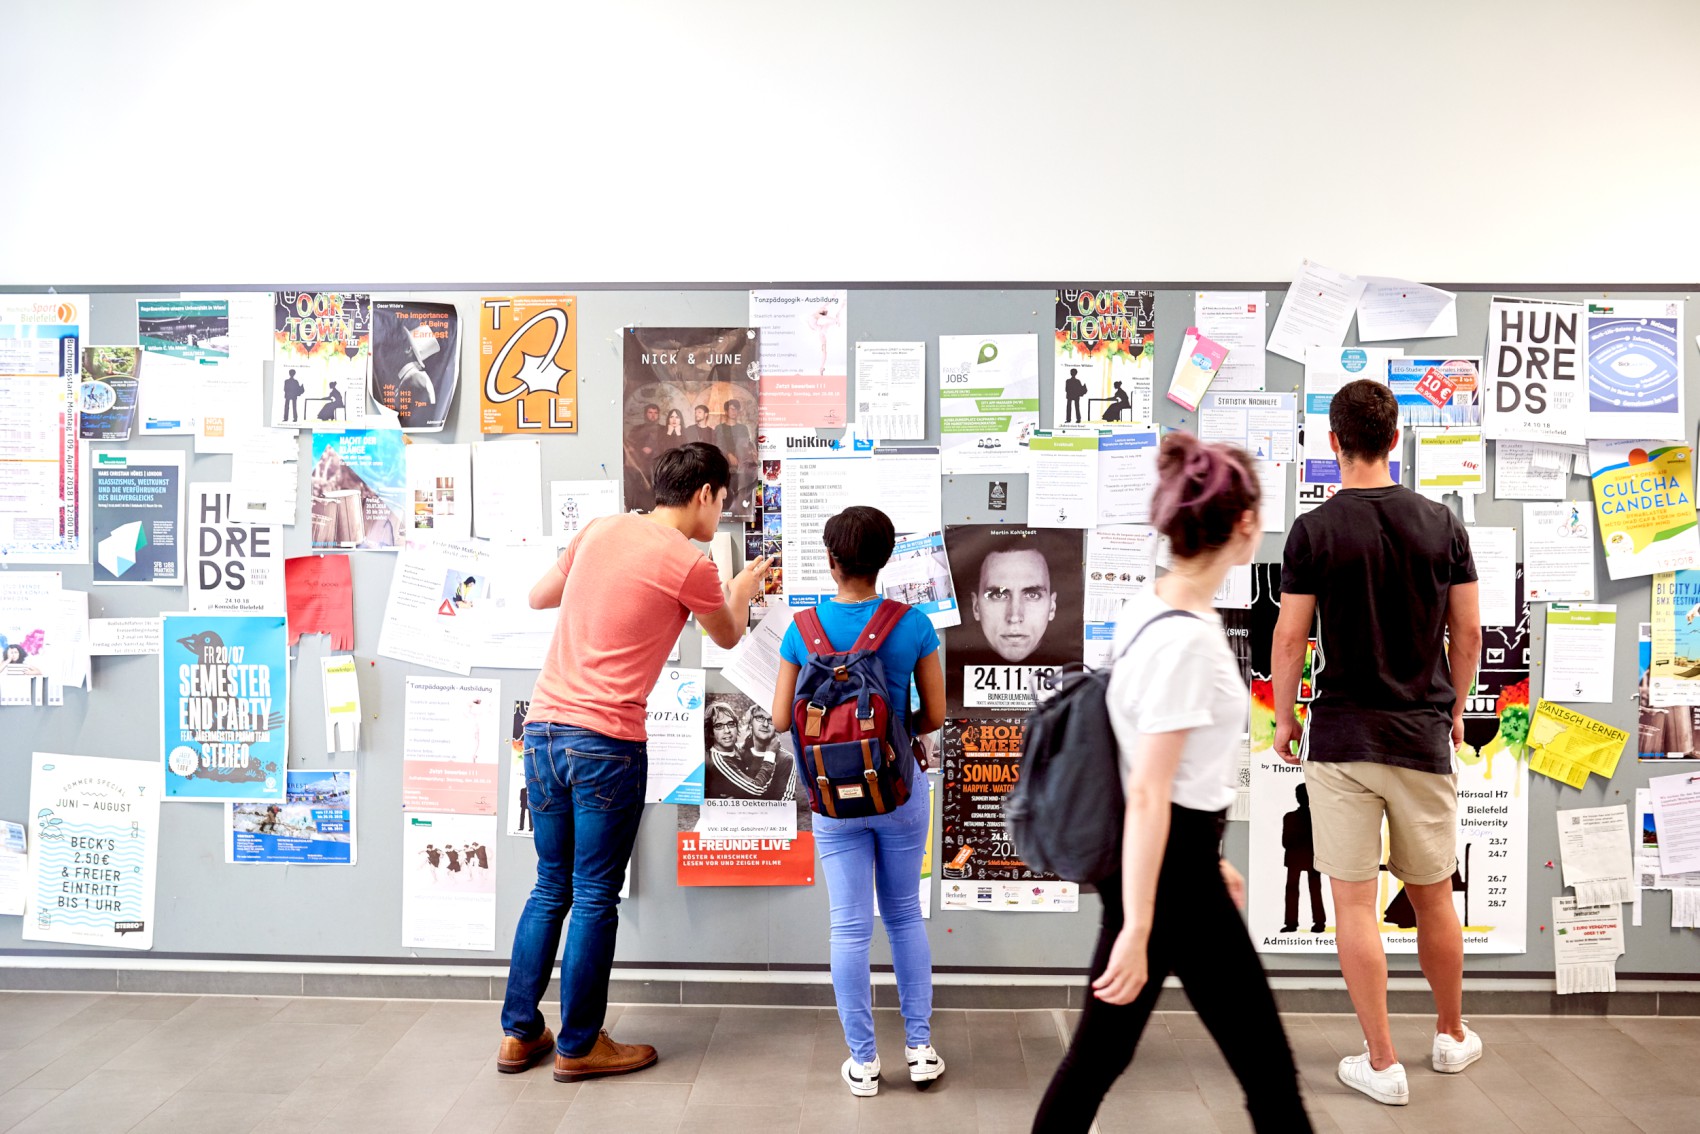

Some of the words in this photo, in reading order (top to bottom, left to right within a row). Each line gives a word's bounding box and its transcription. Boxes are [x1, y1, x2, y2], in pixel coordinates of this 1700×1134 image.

[296, 292, 344, 317] OUR
[1078, 291, 1127, 316] OUR
[410, 312, 449, 322] Importance
[287, 318, 354, 341] TOWN
[419, 320, 427, 328] of
[428, 320, 449, 329] Being
[1066, 316, 1138, 340] TOWN
[1500, 310, 1578, 345] HUN
[413, 331, 449, 339] Earnest
[641, 353, 678, 365] NICK
[687, 353, 696, 365] &
[706, 353, 743, 365] JUNE
[1497, 345, 1576, 381] DRE
[946, 374, 969, 384] JOBS
[383, 384, 395, 392] July
[1422, 374, 1441, 393] 10
[1440, 386, 1453, 401] €
[1496, 381, 1547, 414] DS
[66, 401, 74, 431] Montag
[66, 456, 75, 475] April
[1603, 475, 1681, 498] CULCHA
[1601, 491, 1689, 515] CANDELA
[66, 530, 74, 544] Uhr
[990, 529, 1009, 537] Martin
[1010, 528, 1037, 536] Kohlstedt
[200, 527, 271, 558] DRE
[199, 560, 246, 591] DS
[1669, 583, 1690, 595] CITY
[1227, 628, 1249, 638] (SWE)
[204, 646, 215, 664] FR
[216, 646, 245, 664] 20/07
[179, 664, 272, 698] SEMESTER
[179, 697, 214, 731] END
[215, 697, 273, 732] PARTY
[1538, 702, 1584, 726] SPANISCH
[1586, 721, 1626, 742] LERNEN
[201, 743, 250, 769] STEREO
[63, 777, 94, 793] SOMMER
[96, 778, 128, 798] SPECIAL
[963, 784, 989, 793] HARPYIE
[1456, 790, 1492, 799] Hörsaal
[1495, 790, 1509, 799] H7
[56, 799, 80, 809] JUNI
[93, 801, 132, 813] AUGUST
[1467, 805, 1508, 814] Bielefeld
[1460, 818, 1508, 828] University
[71, 836, 116, 851] BECK'S
[991, 833, 1003, 841] 24.
[1489, 838, 1507, 846] 23.7
[682, 839, 697, 851] 11
[698, 839, 760, 851] FREUNDE
[761, 839, 791, 851] LIVE
[1488, 850, 1507, 858] 24.7
[61, 866, 70, 878] &
[75, 867, 122, 882] FREIER
[1488, 875, 1507, 883] 26.7
[63, 881, 119, 897] EINTRITT
[1488, 887, 1507, 895] 27.7
[58, 896, 79, 909] BIS
[84, 898, 90, 910] 1
[96, 899, 122, 912] UHR
[1488, 899, 1507, 907] 28.7
[116, 922, 140, 930] STEREO
[1263, 937, 1313, 946] Admission
